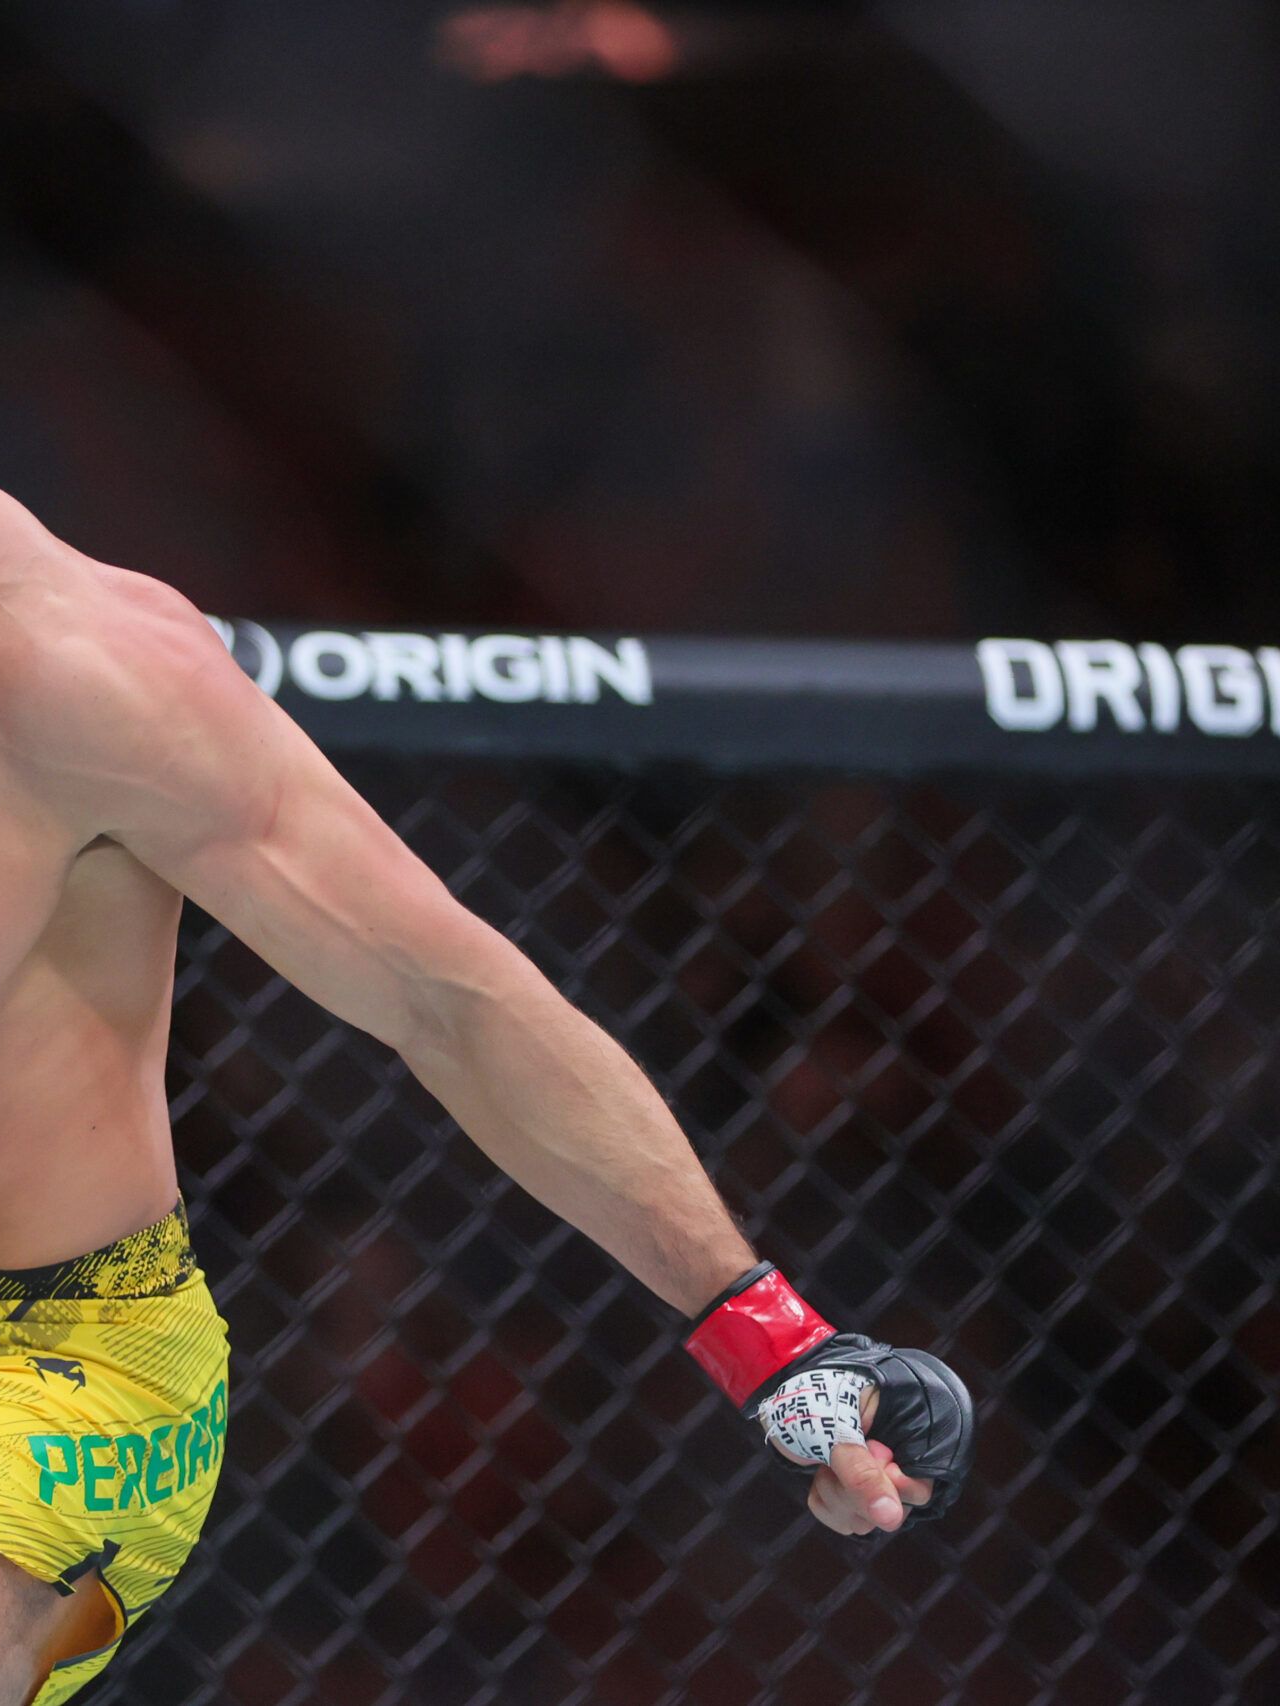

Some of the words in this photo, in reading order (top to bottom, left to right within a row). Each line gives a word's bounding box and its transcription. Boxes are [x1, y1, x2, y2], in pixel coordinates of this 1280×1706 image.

[288, 631, 653, 705] ORIGIN
[809, 1372, 828, 1403] UFC
[27, 1379, 227, 1512] PEREIRA
